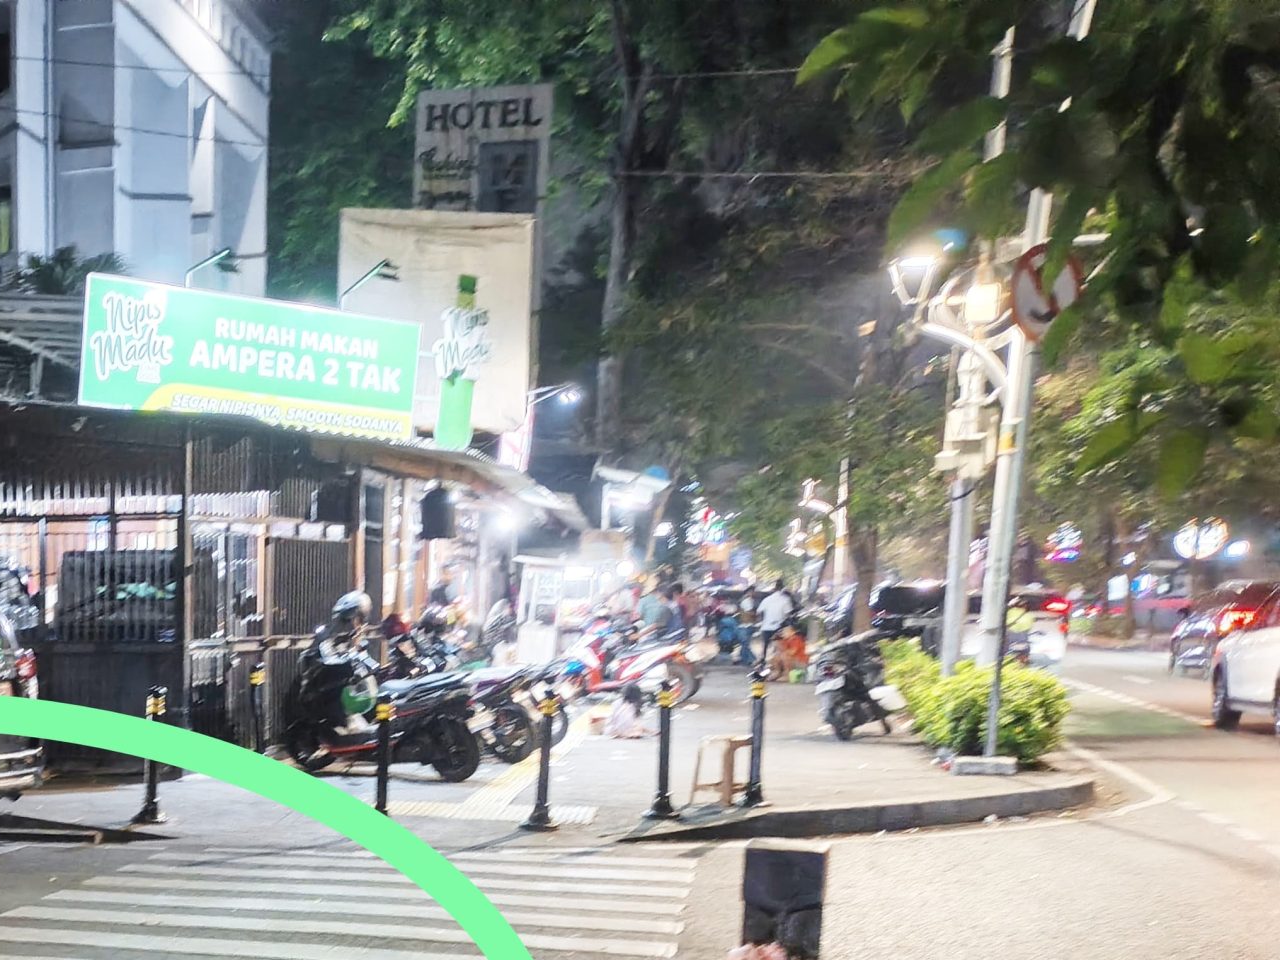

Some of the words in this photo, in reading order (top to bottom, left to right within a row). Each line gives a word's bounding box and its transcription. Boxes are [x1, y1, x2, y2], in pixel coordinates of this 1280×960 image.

[424, 97, 543, 132] HOTEL
[92, 327, 170, 377] Madu
[215, 317, 296, 347] RUMAH
[300, 330, 379, 359] MAKAN
[189, 339, 316, 382] AMPERA
[322, 357, 340, 386] 2
[346, 361, 402, 394] TAK
[172, 393, 218, 413] SEGAR
[286, 407, 342, 427] SMOOTH
[344, 414, 403, 434] SODANYA
